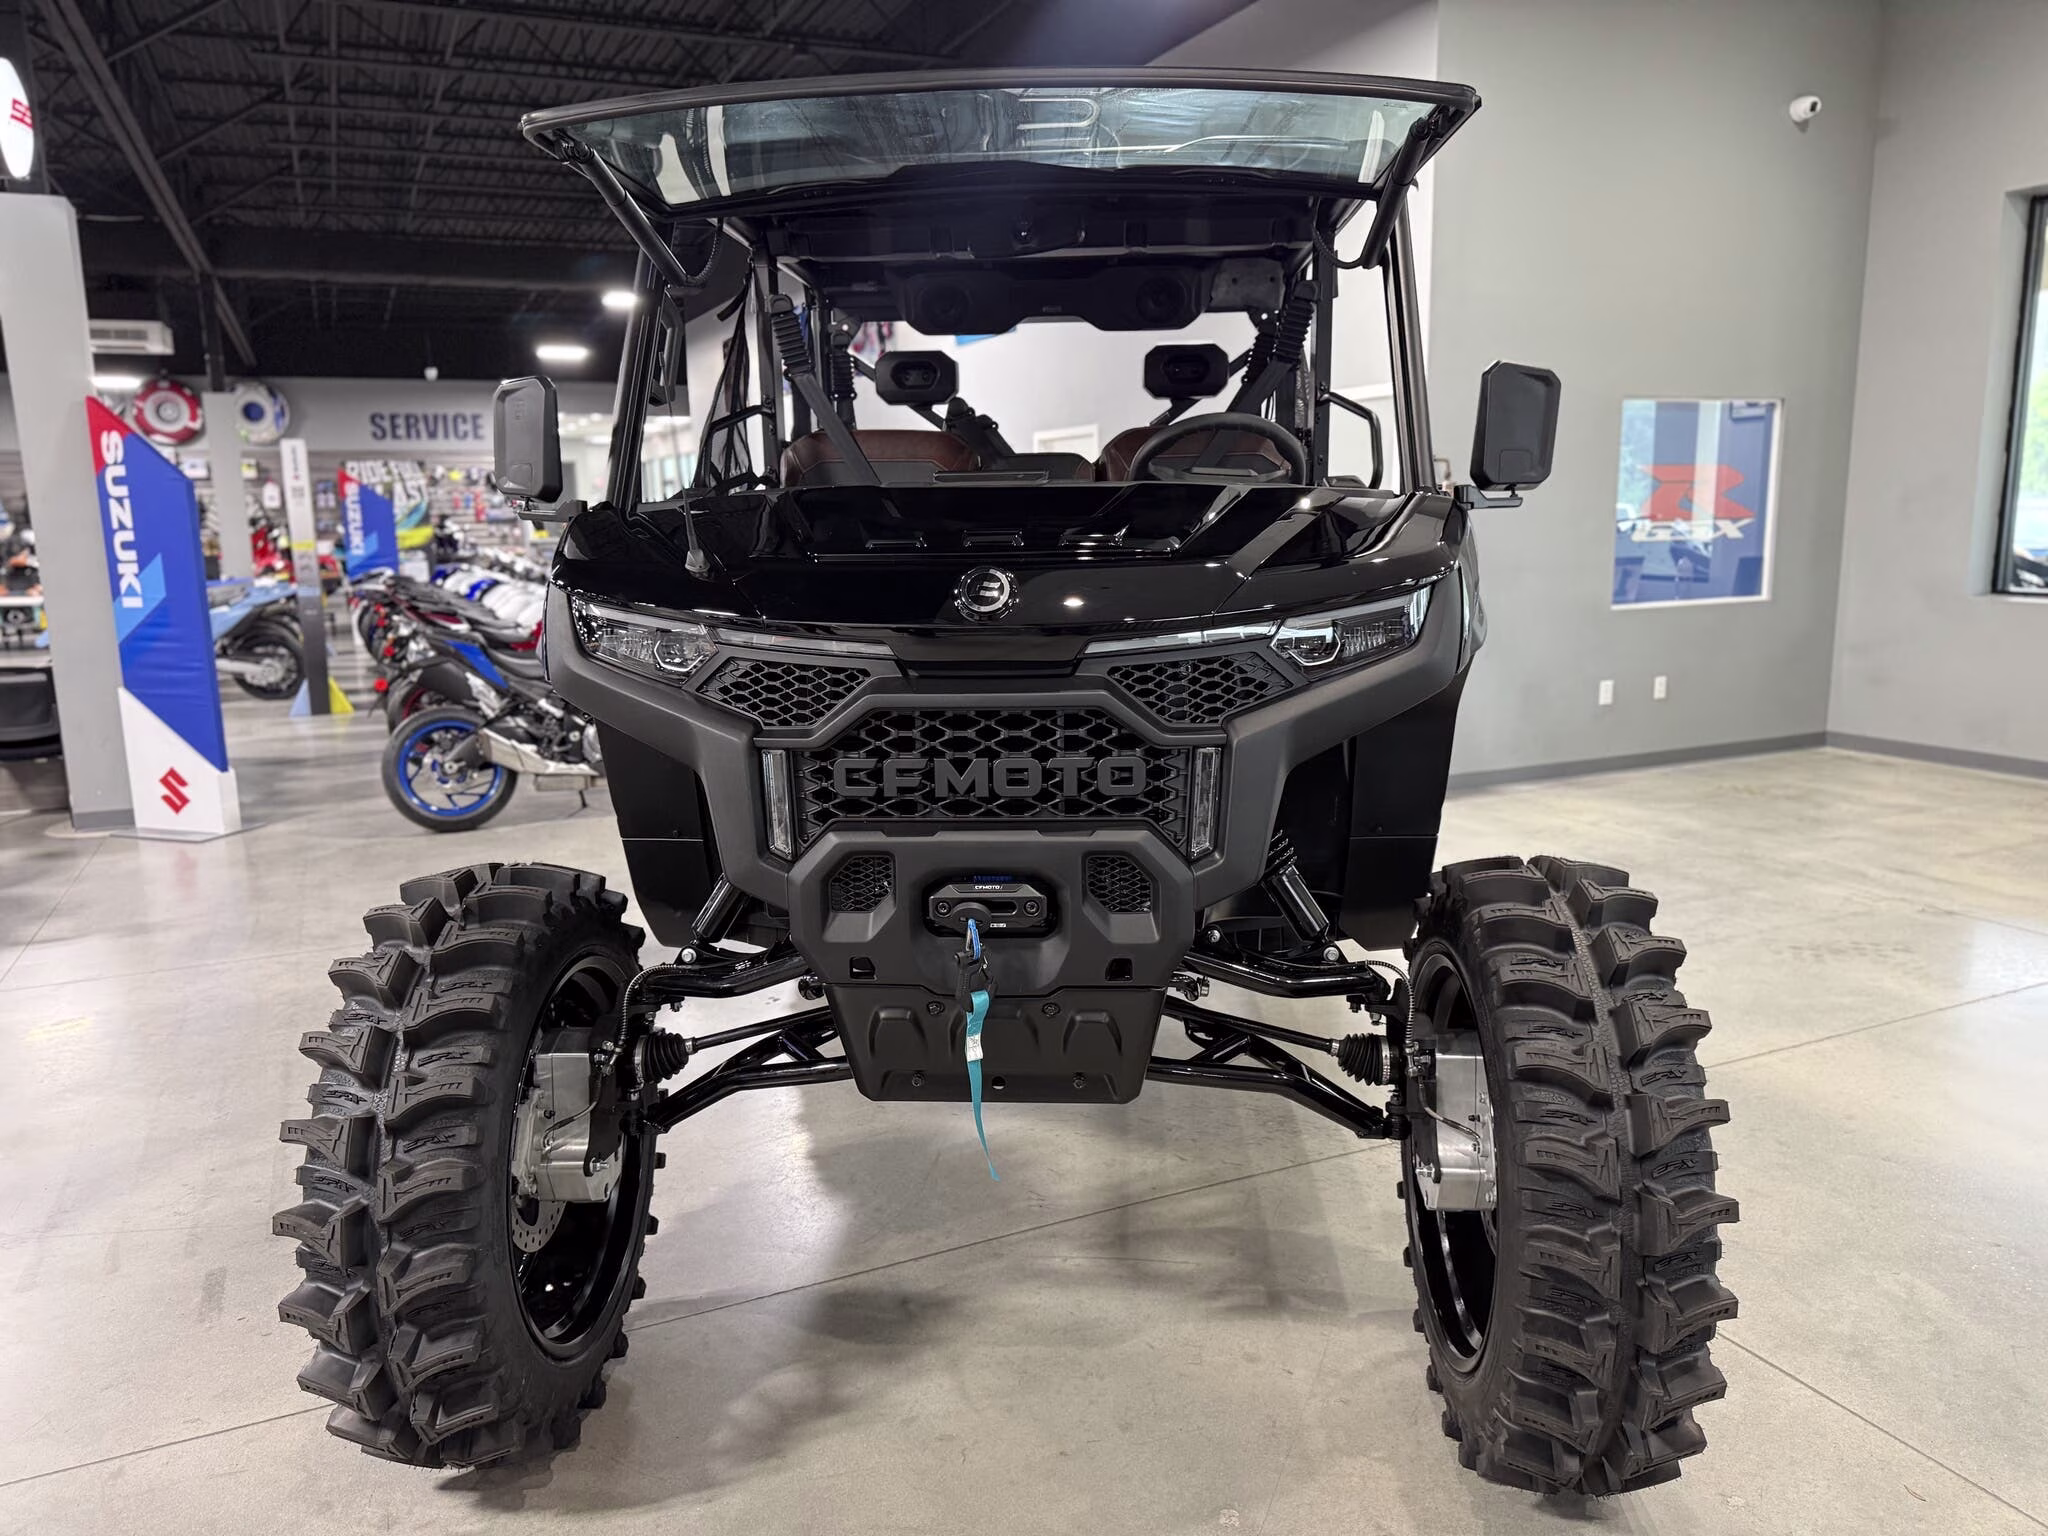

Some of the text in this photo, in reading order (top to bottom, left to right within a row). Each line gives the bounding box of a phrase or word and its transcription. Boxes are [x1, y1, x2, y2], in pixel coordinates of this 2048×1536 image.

[370, 412, 485, 441] SERVICE
[100, 430, 144, 608] SUZUKI
[833, 757, 1147, 798] CFMOTO
